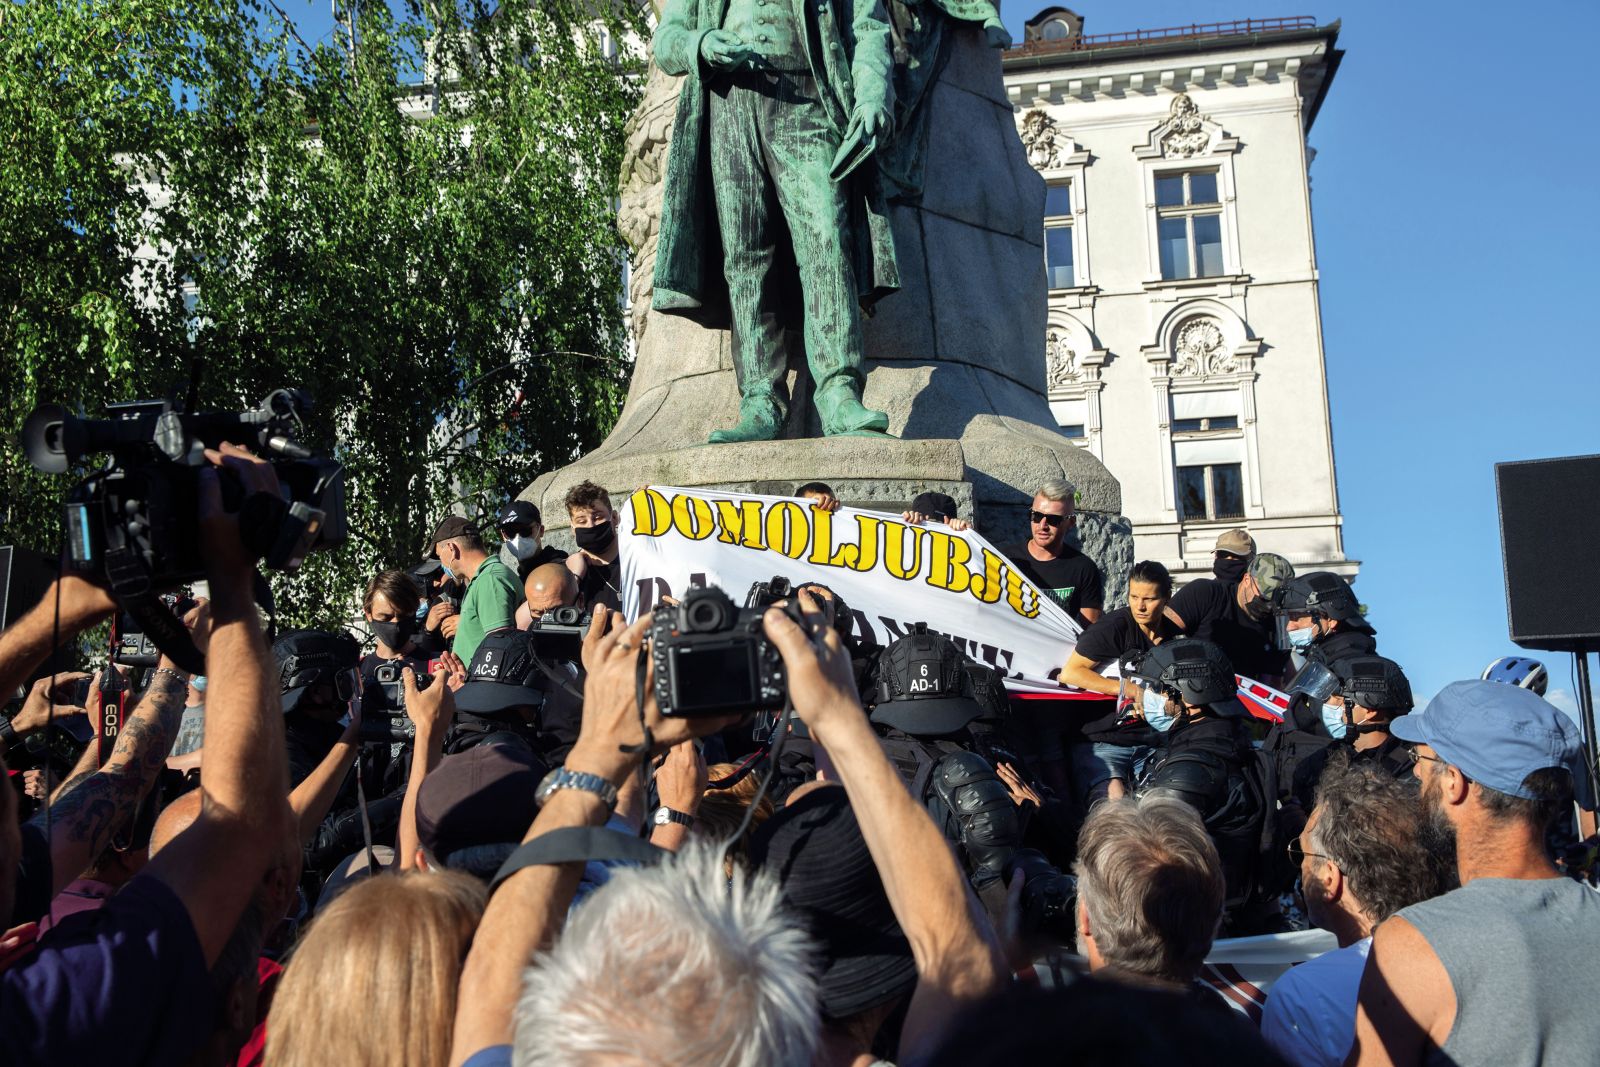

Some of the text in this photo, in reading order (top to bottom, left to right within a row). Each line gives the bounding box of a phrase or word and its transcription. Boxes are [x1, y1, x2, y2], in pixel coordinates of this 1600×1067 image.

[630, 488, 1041, 619] DOMOLJUBJU
[485, 651, 493, 663] 6
[473, 663, 499, 676] AC-5
[920, 664, 928, 677] 6
[910, 678, 939, 692] AD-1
[105, 703, 117, 736] EOS
